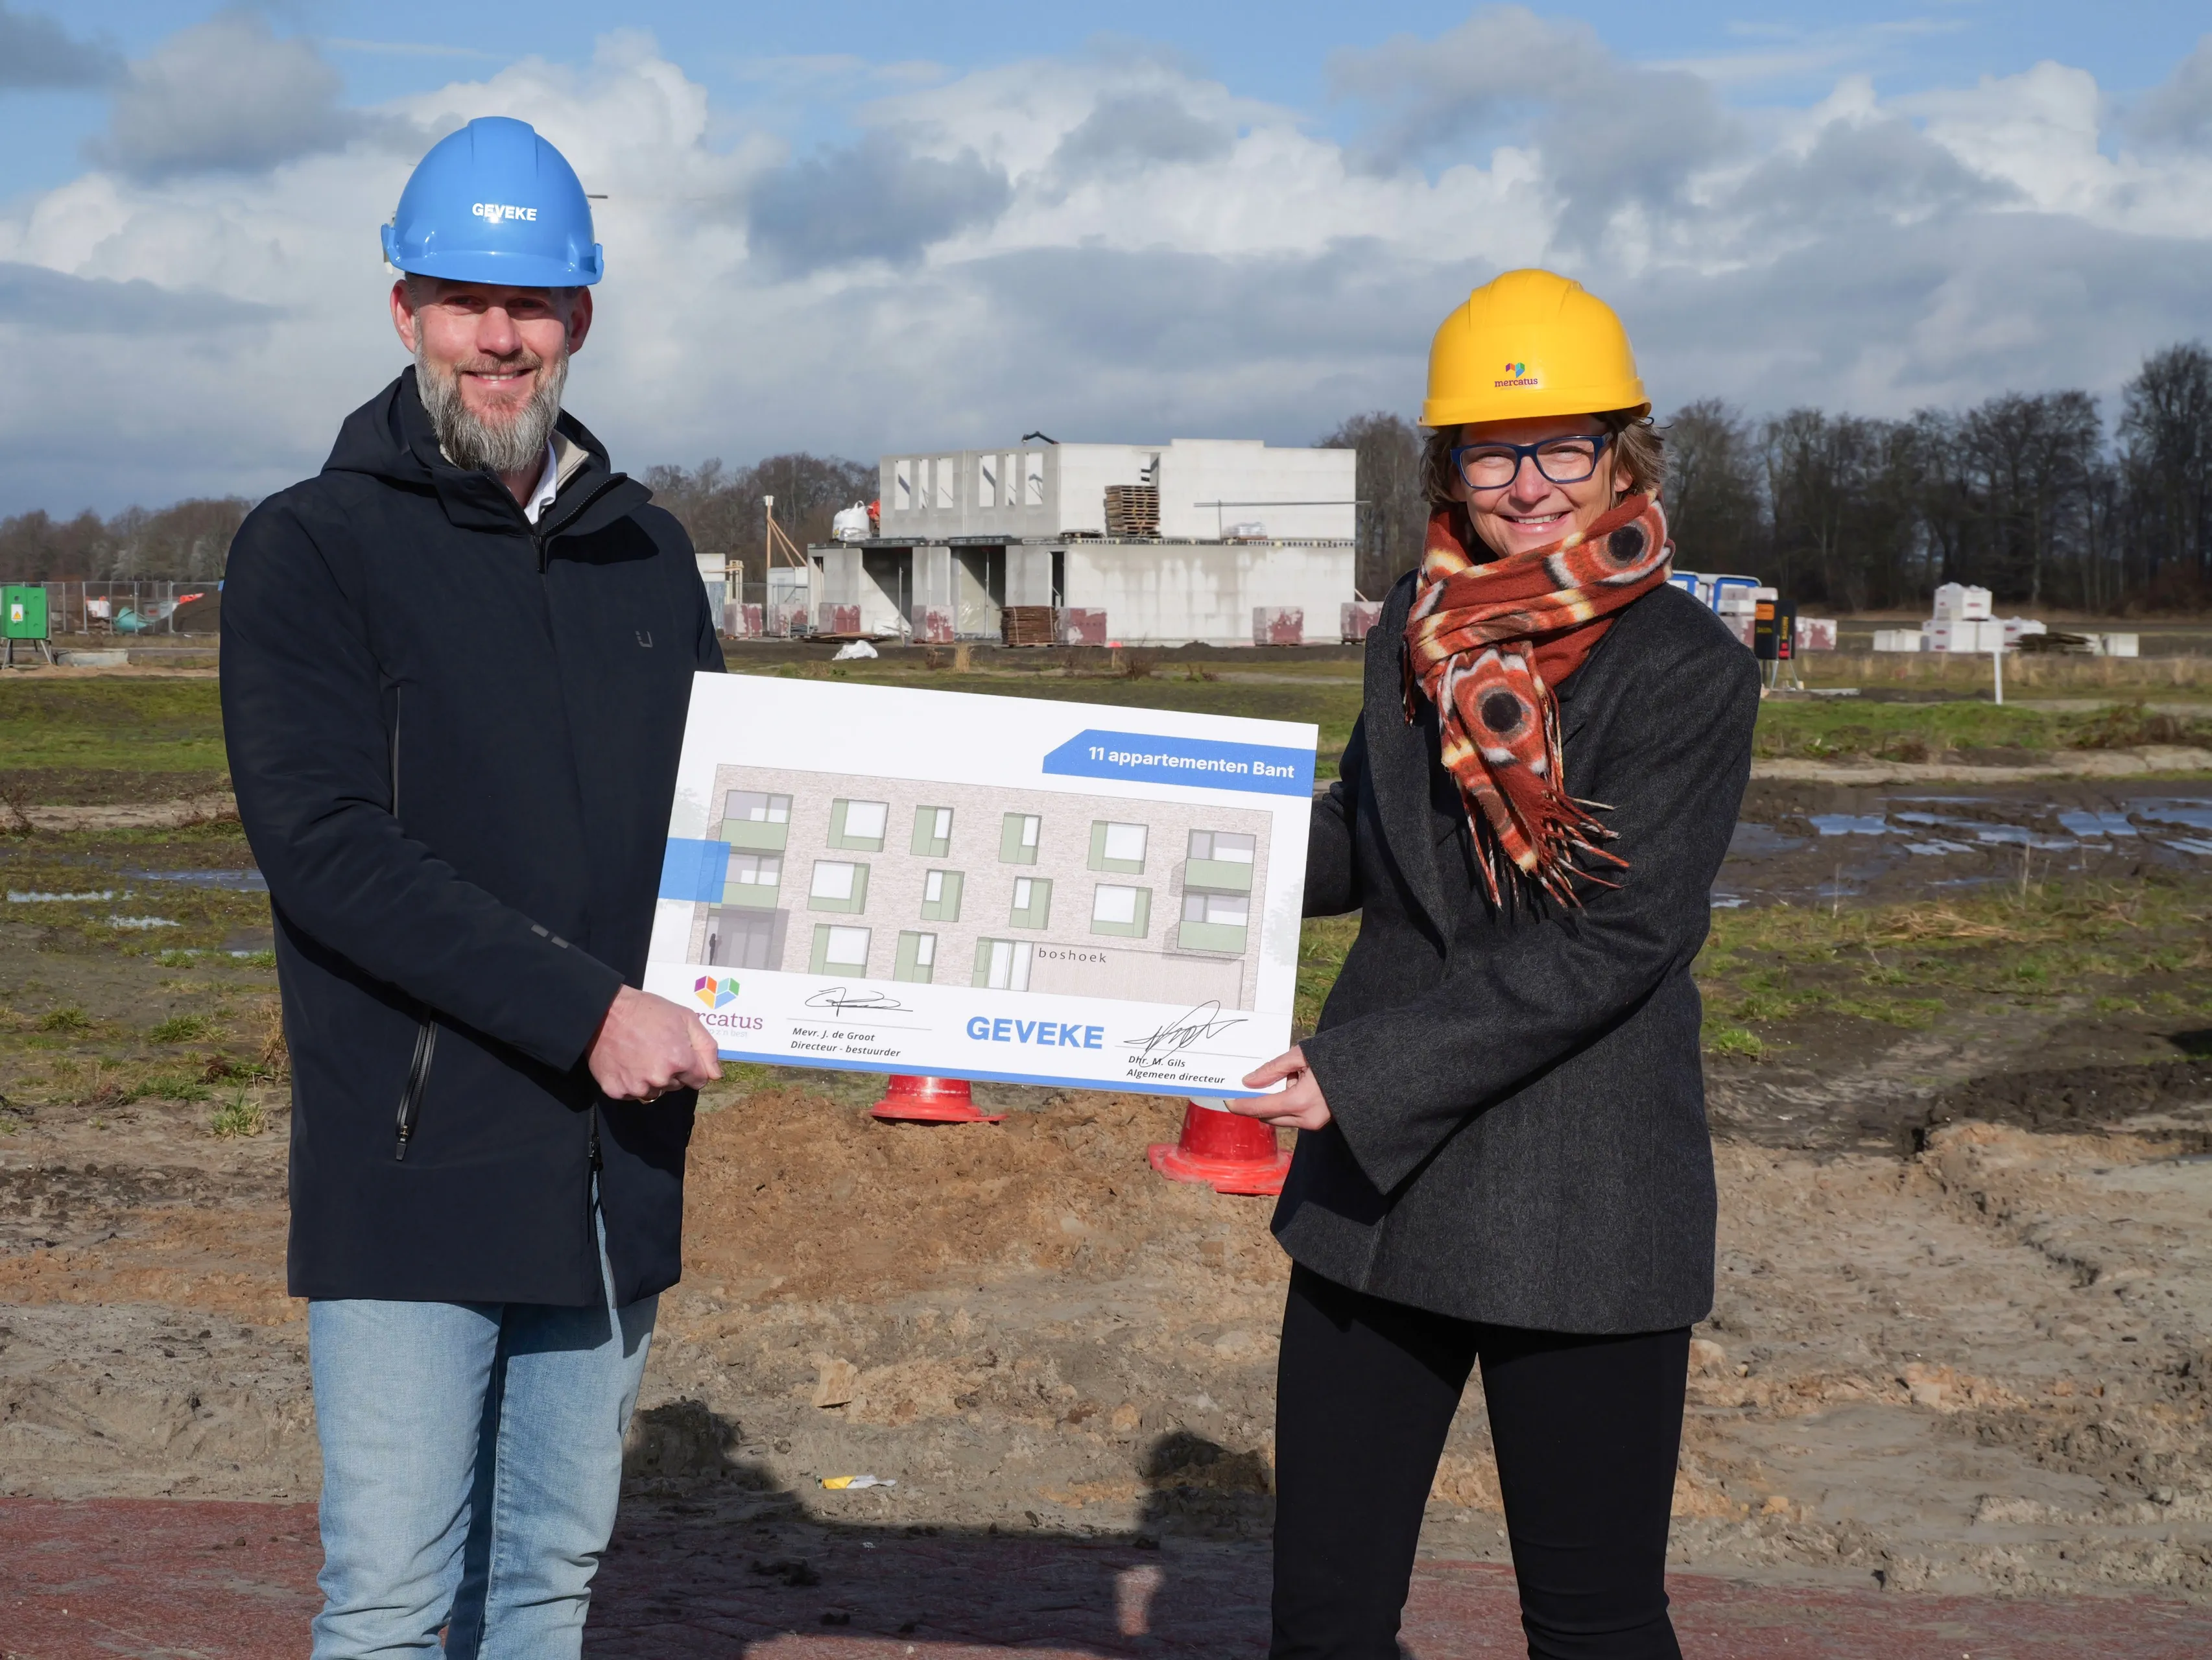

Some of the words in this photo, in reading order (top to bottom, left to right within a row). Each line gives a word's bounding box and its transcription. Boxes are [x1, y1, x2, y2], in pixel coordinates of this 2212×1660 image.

[472, 203, 537, 221] GEVEKE
[1494, 378, 1538, 387] mercatus
[1088, 746, 1104, 761] 11
[1108, 750, 1248, 774] appartementen
[1253, 761, 1294, 778] Bant
[1038, 947, 1107, 963] boshoek
[695, 1012, 763, 1030] rcatus
[730, 1029, 748, 1038] best
[792, 1027, 819, 1038] Mevr.
[822, 1030, 829, 1039] J.
[832, 1029, 844, 1039] de
[847, 1032, 875, 1041] Groot
[966, 1016, 1104, 1049] GEVEKE
[791, 1041, 837, 1052] Directeur
[846, 1046, 901, 1057] bestuurder
[1128, 1056, 1148, 1065] Dhr.
[1167, 1058, 1185, 1067] Gils
[1126, 1069, 1176, 1080] Algemeen
[1179, 1072, 1225, 1084] directeur
